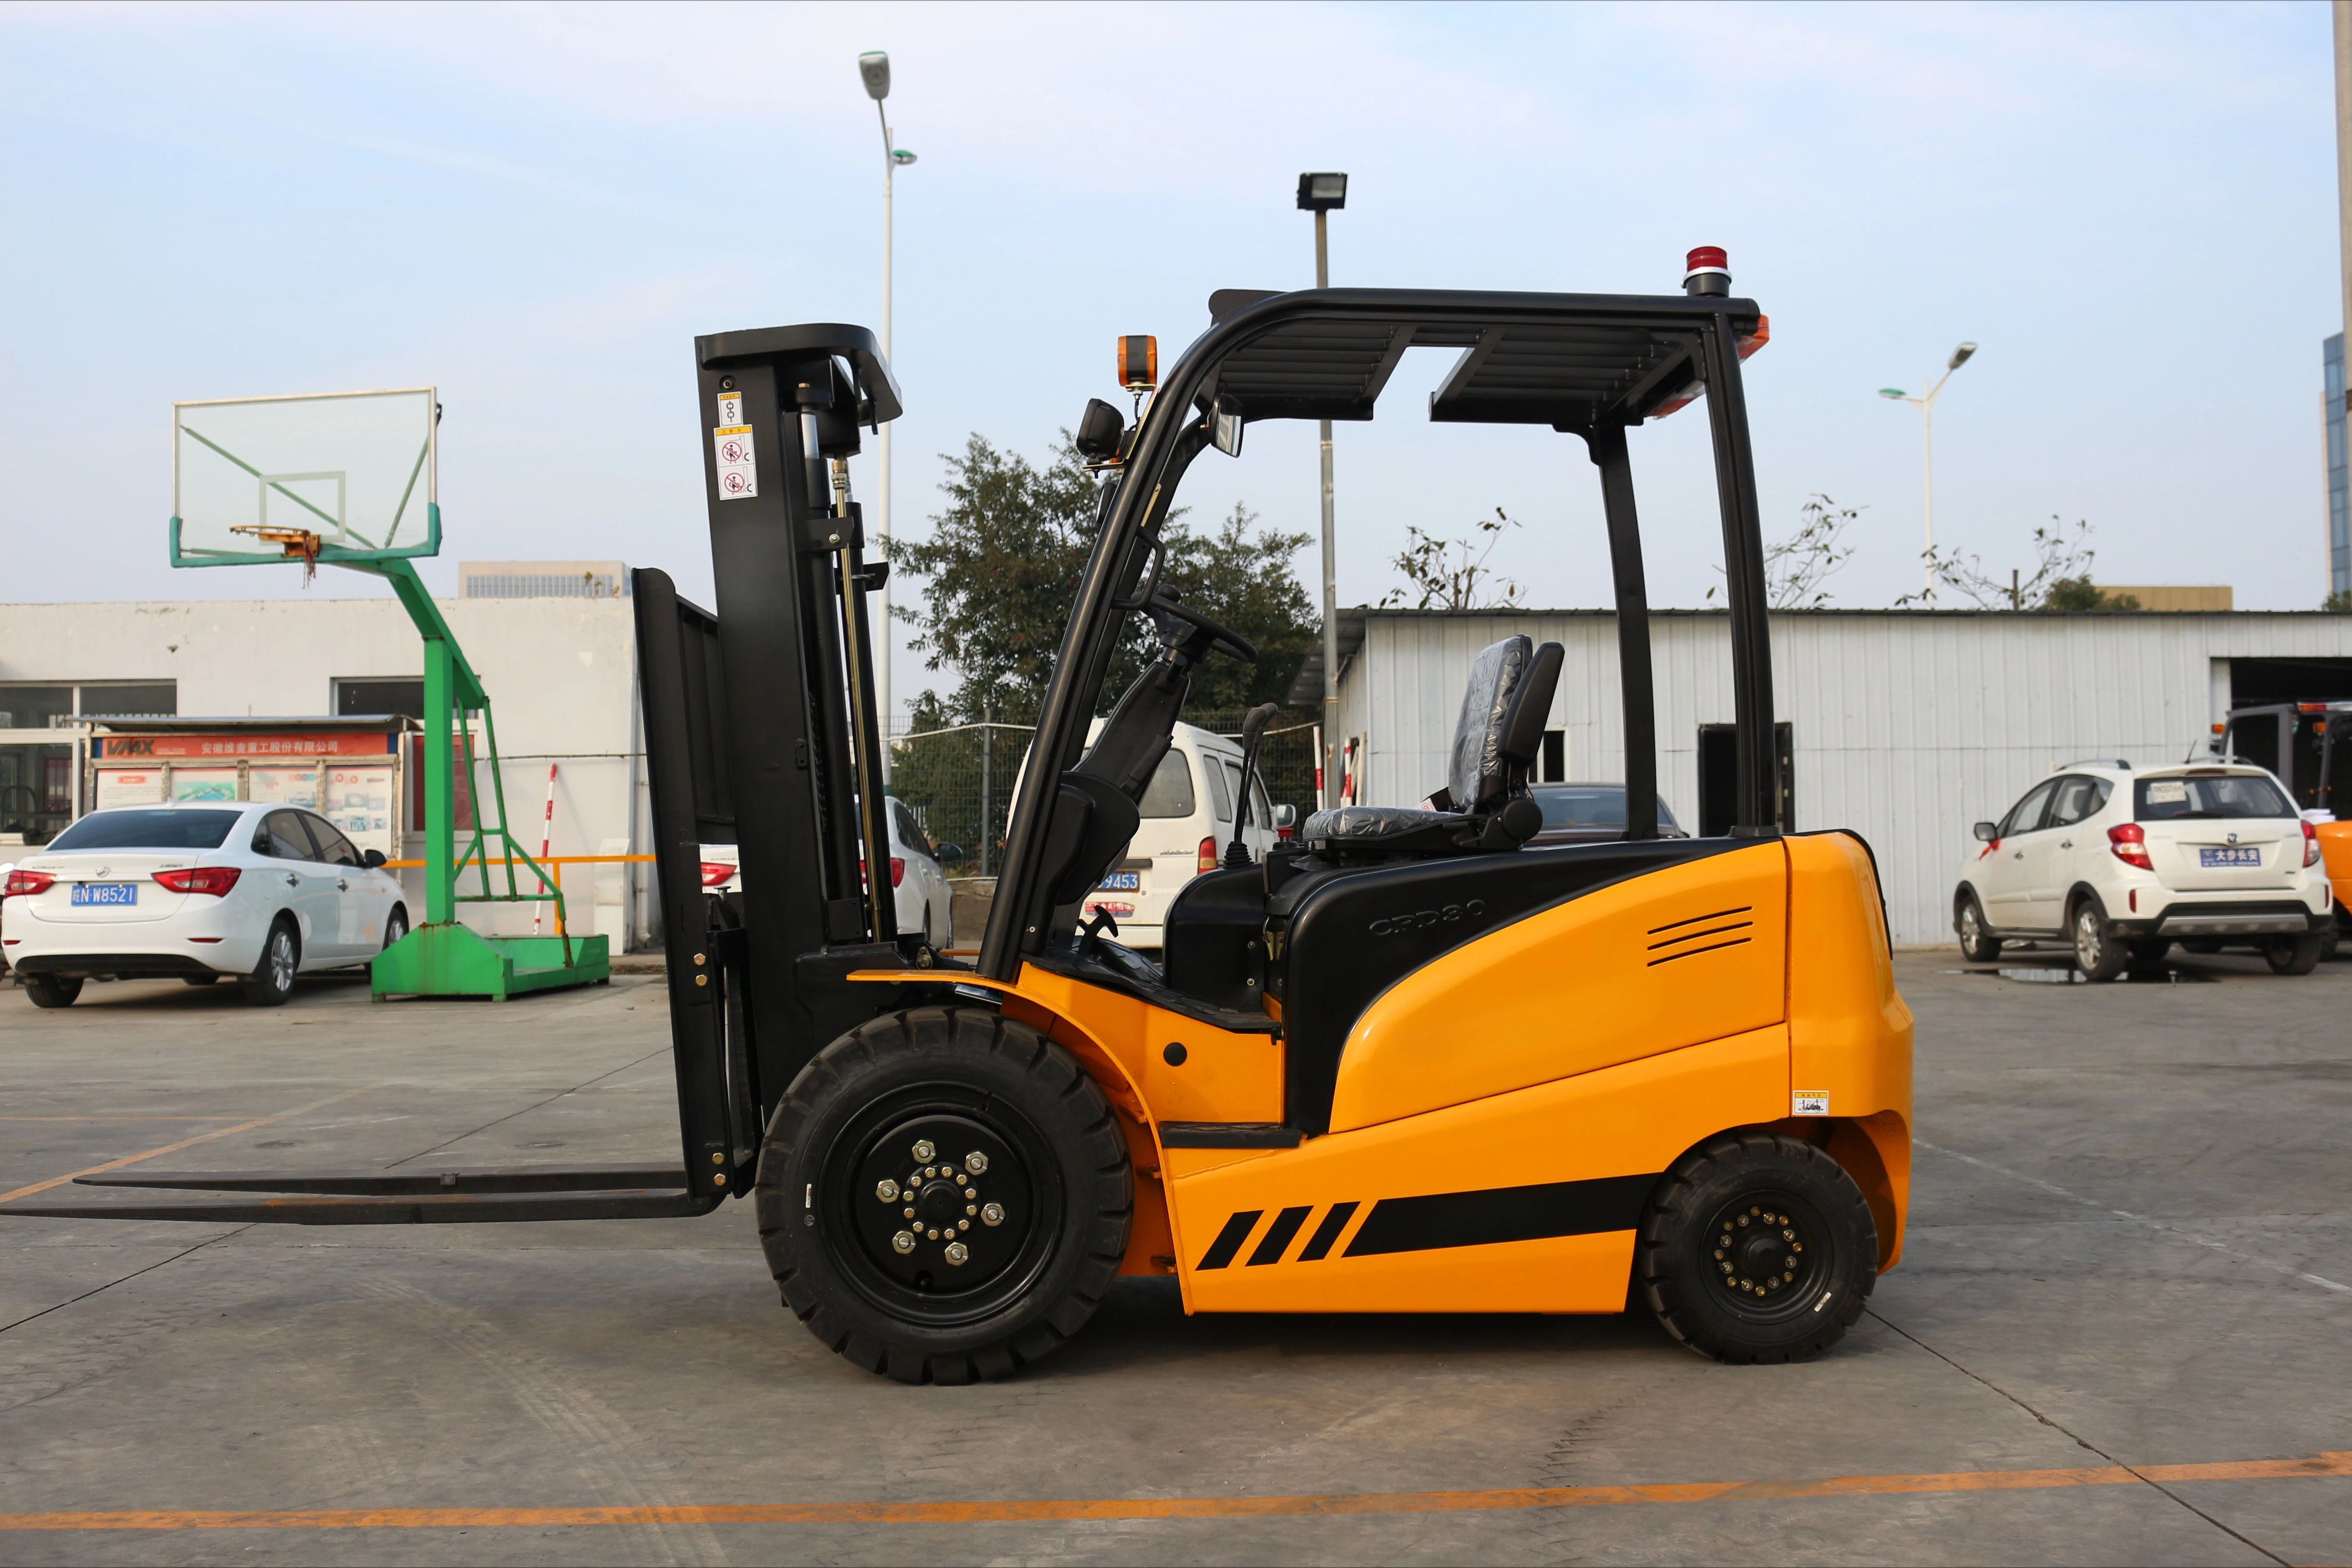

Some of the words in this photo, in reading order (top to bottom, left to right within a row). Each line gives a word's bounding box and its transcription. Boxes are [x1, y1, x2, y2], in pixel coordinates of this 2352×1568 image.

[107, 740, 155, 755] VMX
[201, 740, 338, 754] 安徽维麦重工股份有限公司
